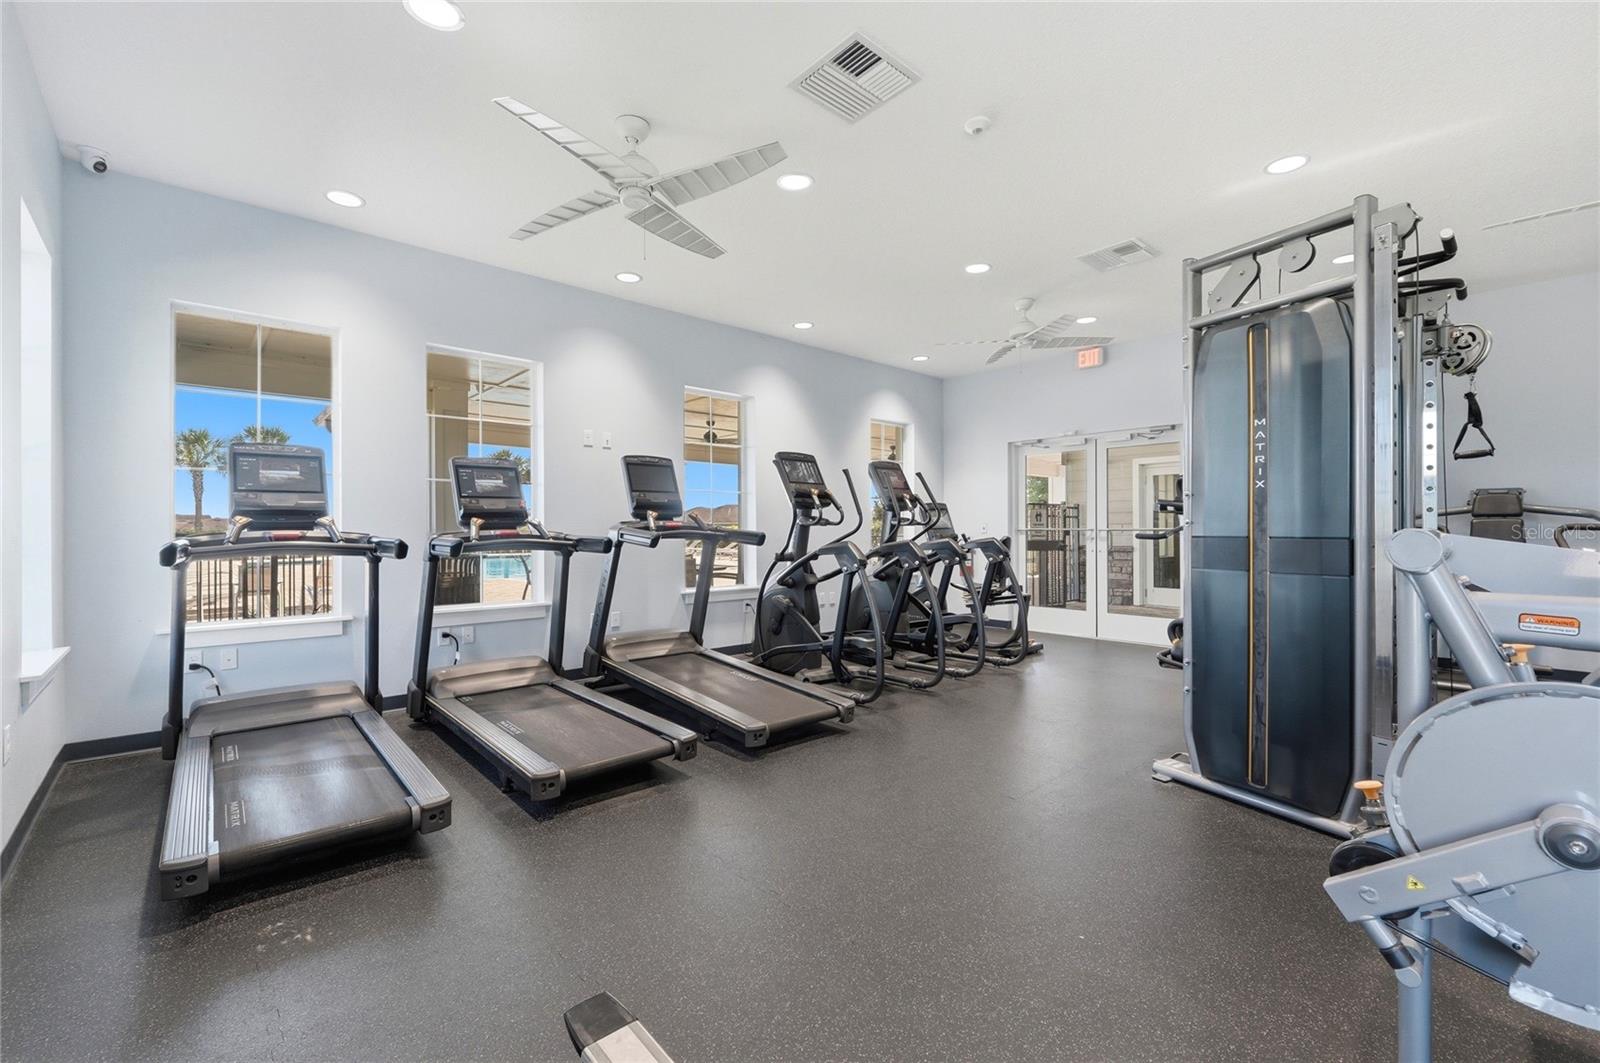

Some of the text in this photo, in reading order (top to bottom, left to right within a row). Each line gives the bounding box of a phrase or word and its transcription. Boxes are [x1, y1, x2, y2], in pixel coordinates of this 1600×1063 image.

[1079, 348, 1100, 368] EXIT
[1254, 418, 1266, 488] MATRIX
[1536, 617, 1577, 627] WARNING
[230, 801, 241, 828] MATRIX
